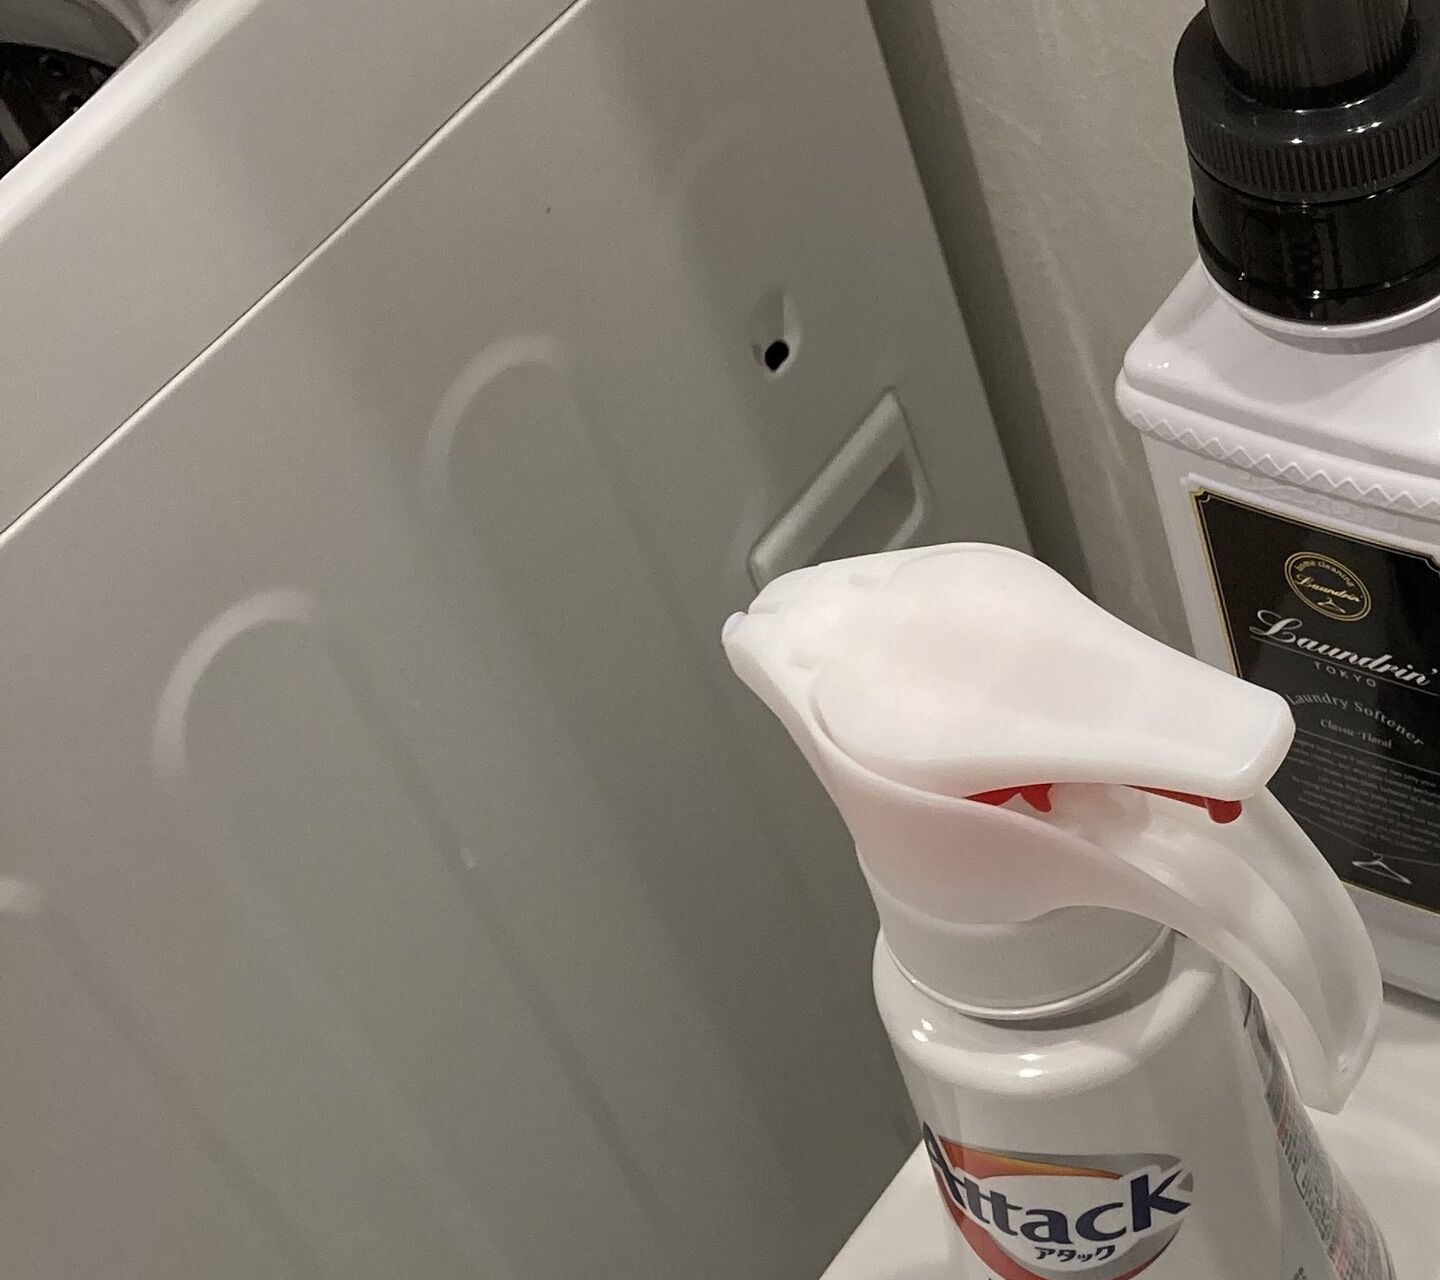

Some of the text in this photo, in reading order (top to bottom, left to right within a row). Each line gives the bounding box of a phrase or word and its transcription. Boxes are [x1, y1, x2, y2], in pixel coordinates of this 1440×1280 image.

[1248, 609, 1439, 687] Laundrin'
[1313, 661, 1377, 687] TOKYO
[1285, 692, 1424, 746] Laundry Softener
[923, 1121, 1192, 1245] Attack
[1034, 1244, 1116, 1262] アタック
